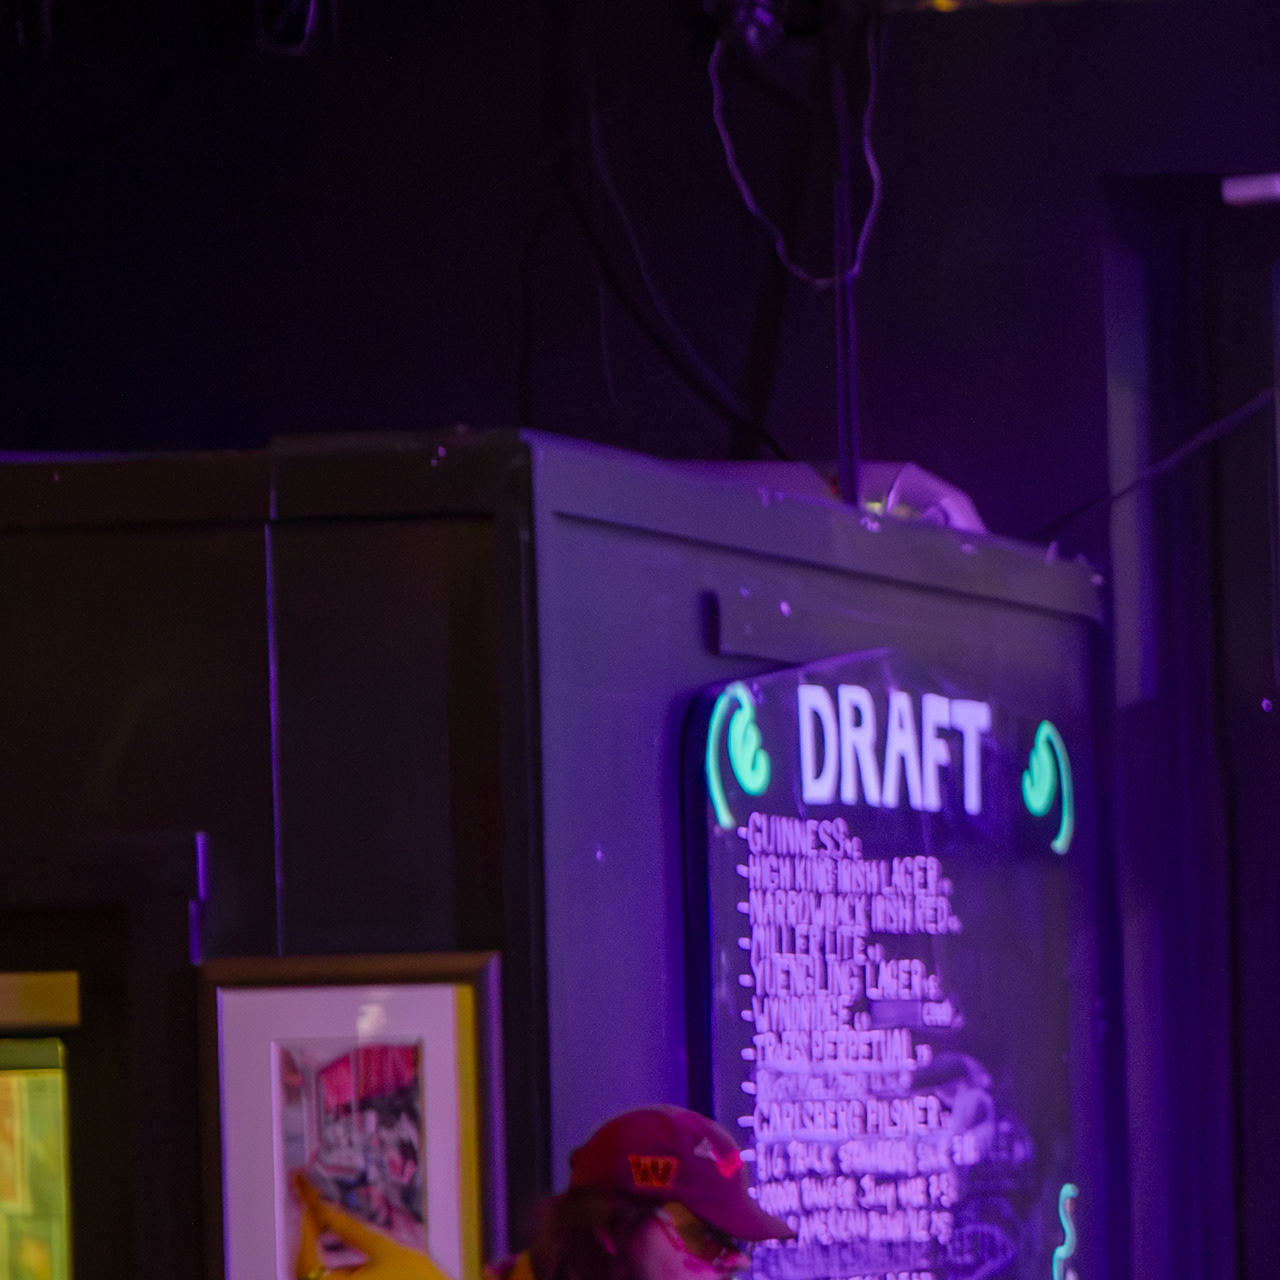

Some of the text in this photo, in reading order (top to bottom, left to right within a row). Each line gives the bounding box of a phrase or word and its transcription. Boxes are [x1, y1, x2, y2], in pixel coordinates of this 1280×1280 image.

[797, 684, 991, 815] DRAFT
[749, 812, 848, 859] GUINNESS
[749, 854, 792, 892] HIGH
[881, 855, 943, 898] LAGER
[752, 924, 822, 961] MILLER
[752, 953, 861, 998] YUENGLING
[866, 958, 927, 1001] LAGER
[755, 1095, 943, 1138] CARLSBERG PILSNER
